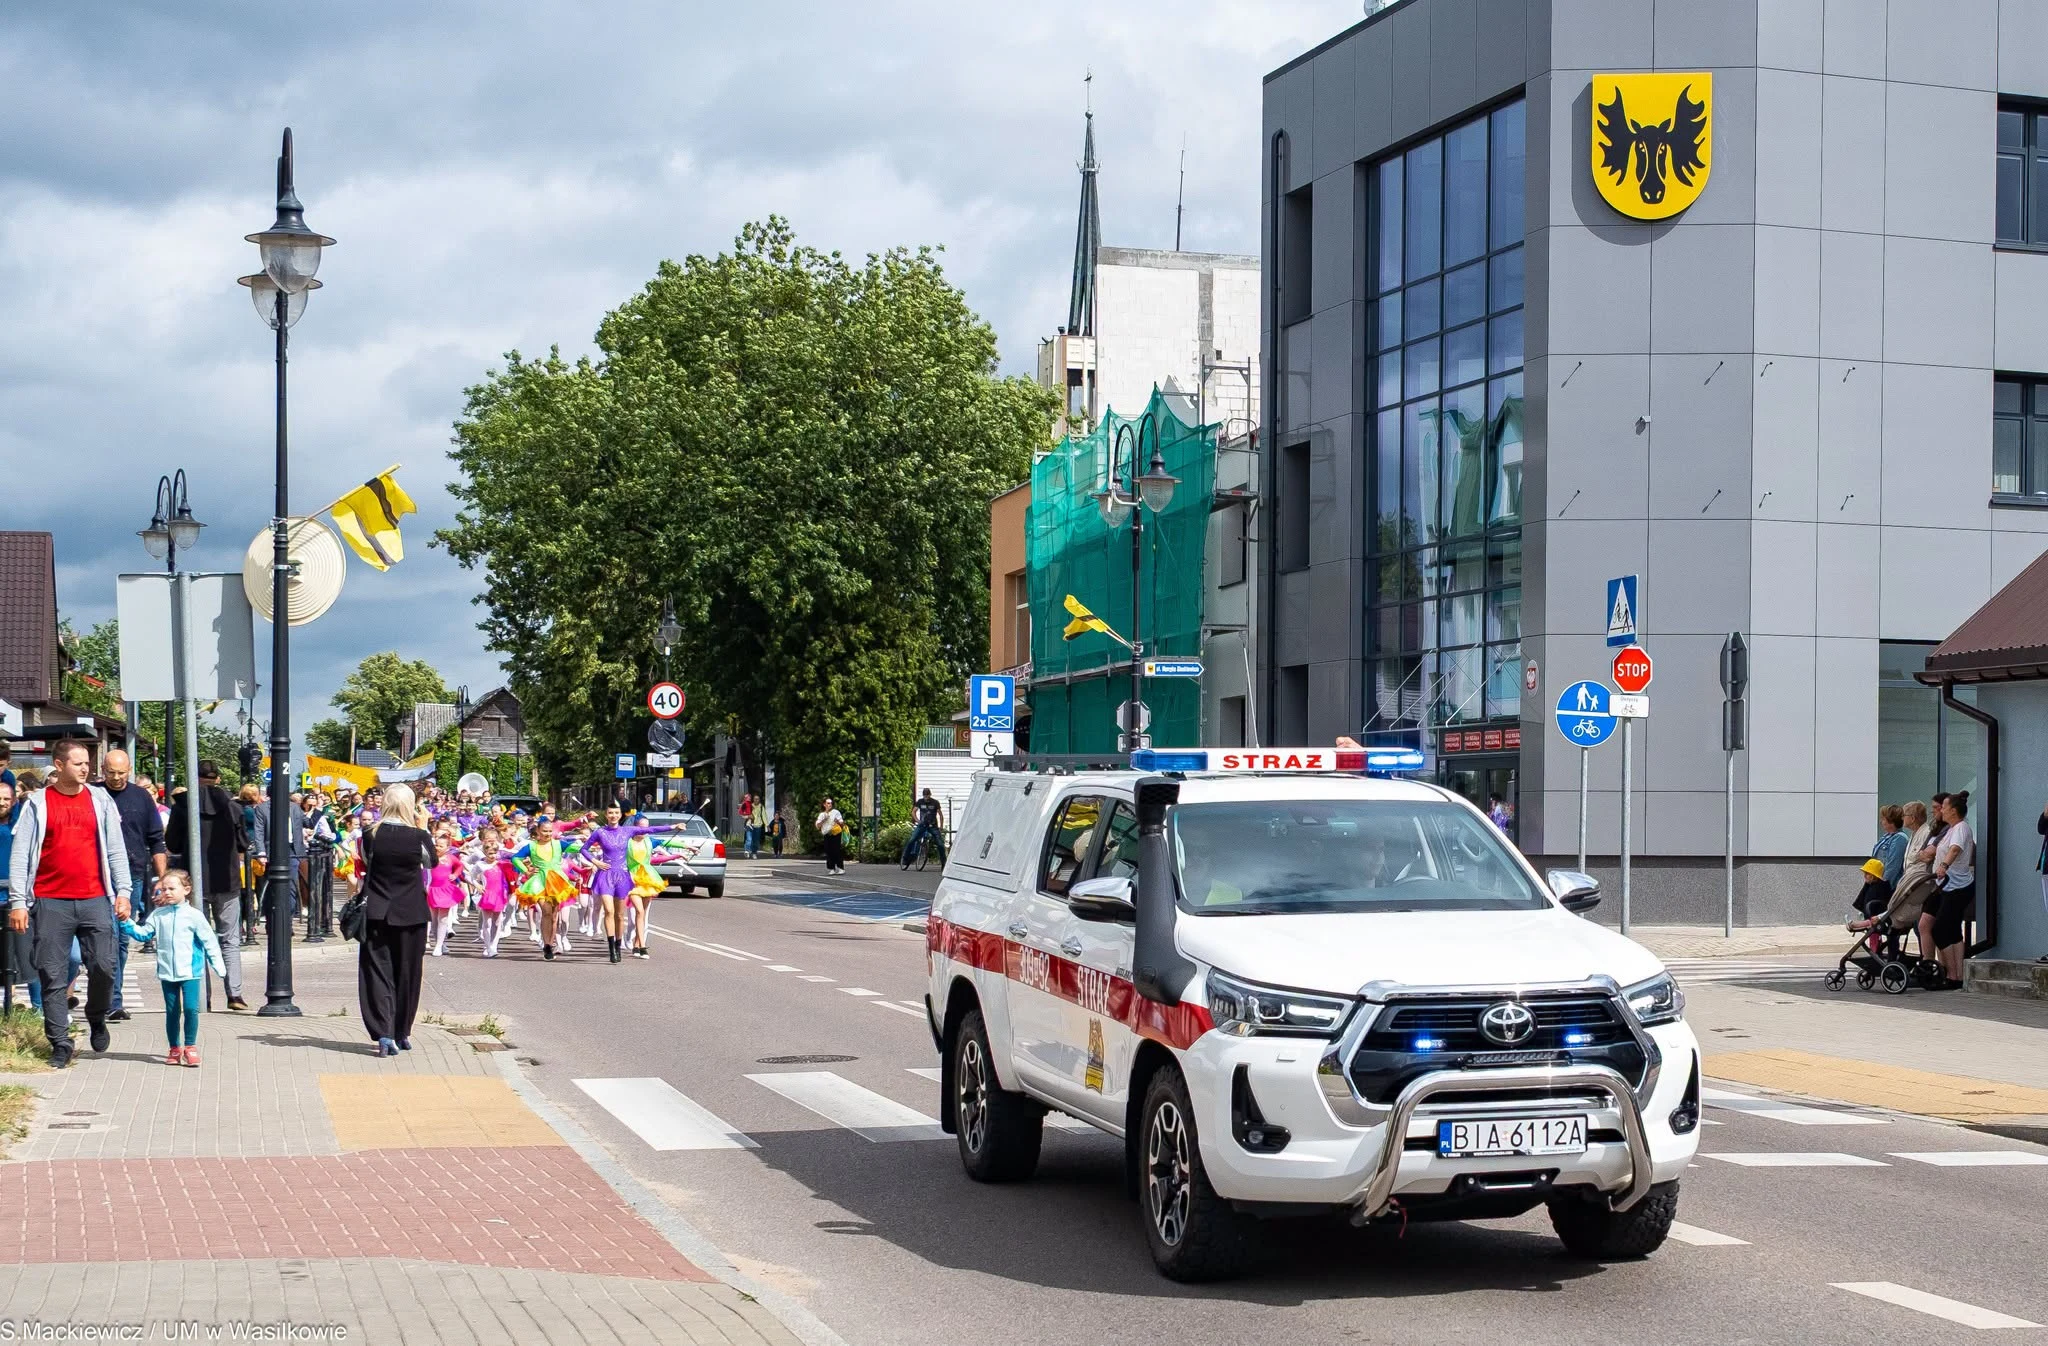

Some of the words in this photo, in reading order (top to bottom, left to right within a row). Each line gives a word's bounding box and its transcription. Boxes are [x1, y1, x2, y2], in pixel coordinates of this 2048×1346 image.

[1617, 663, 1648, 677] STOP
[655, 692, 680, 709] 40
[980, 680, 1006, 715] P
[972, 716, 987, 727] 2x
[1454, 1124, 1501, 1149] BIA
[1511, 1120, 1582, 1147] 6112A
